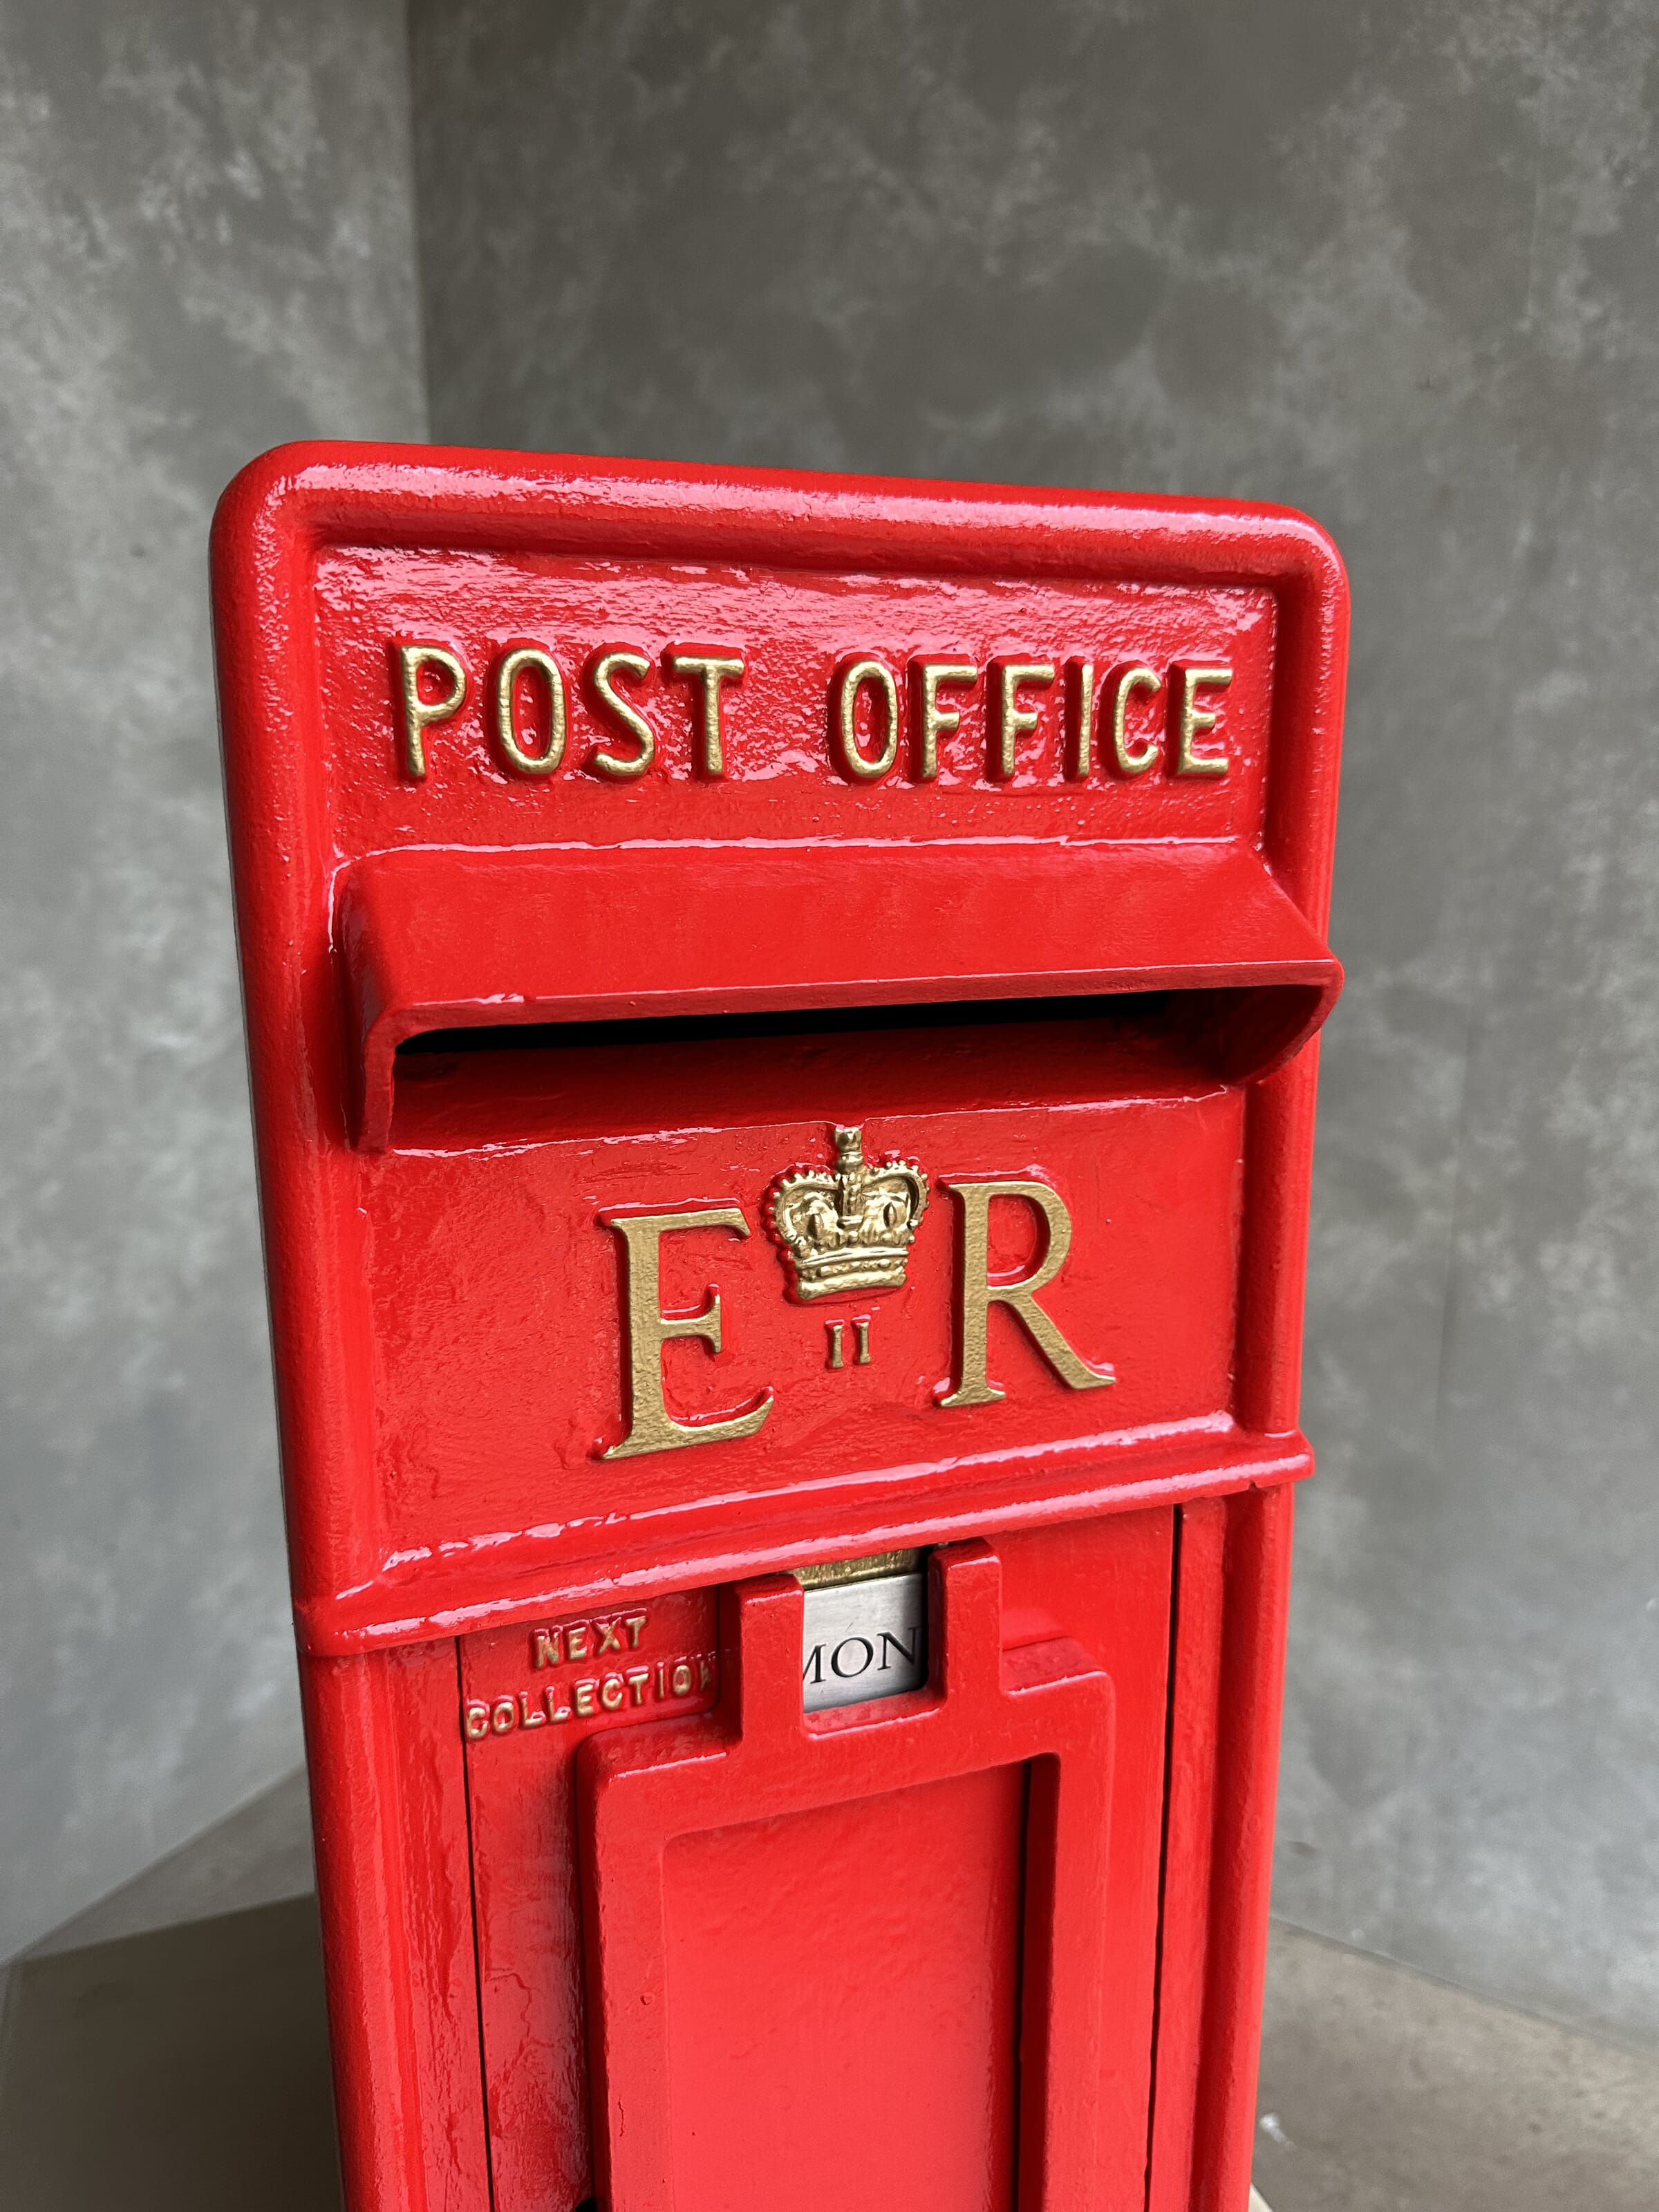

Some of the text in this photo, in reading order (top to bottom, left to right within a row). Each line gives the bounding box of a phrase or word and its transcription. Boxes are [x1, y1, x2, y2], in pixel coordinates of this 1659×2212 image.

[400, 644, 1234, 779] POST OFFICE
[602, 1179, 1116, 1460] E R
[829, 1322, 871, 1369] II
[535, 1614, 648, 1669] NEXT
